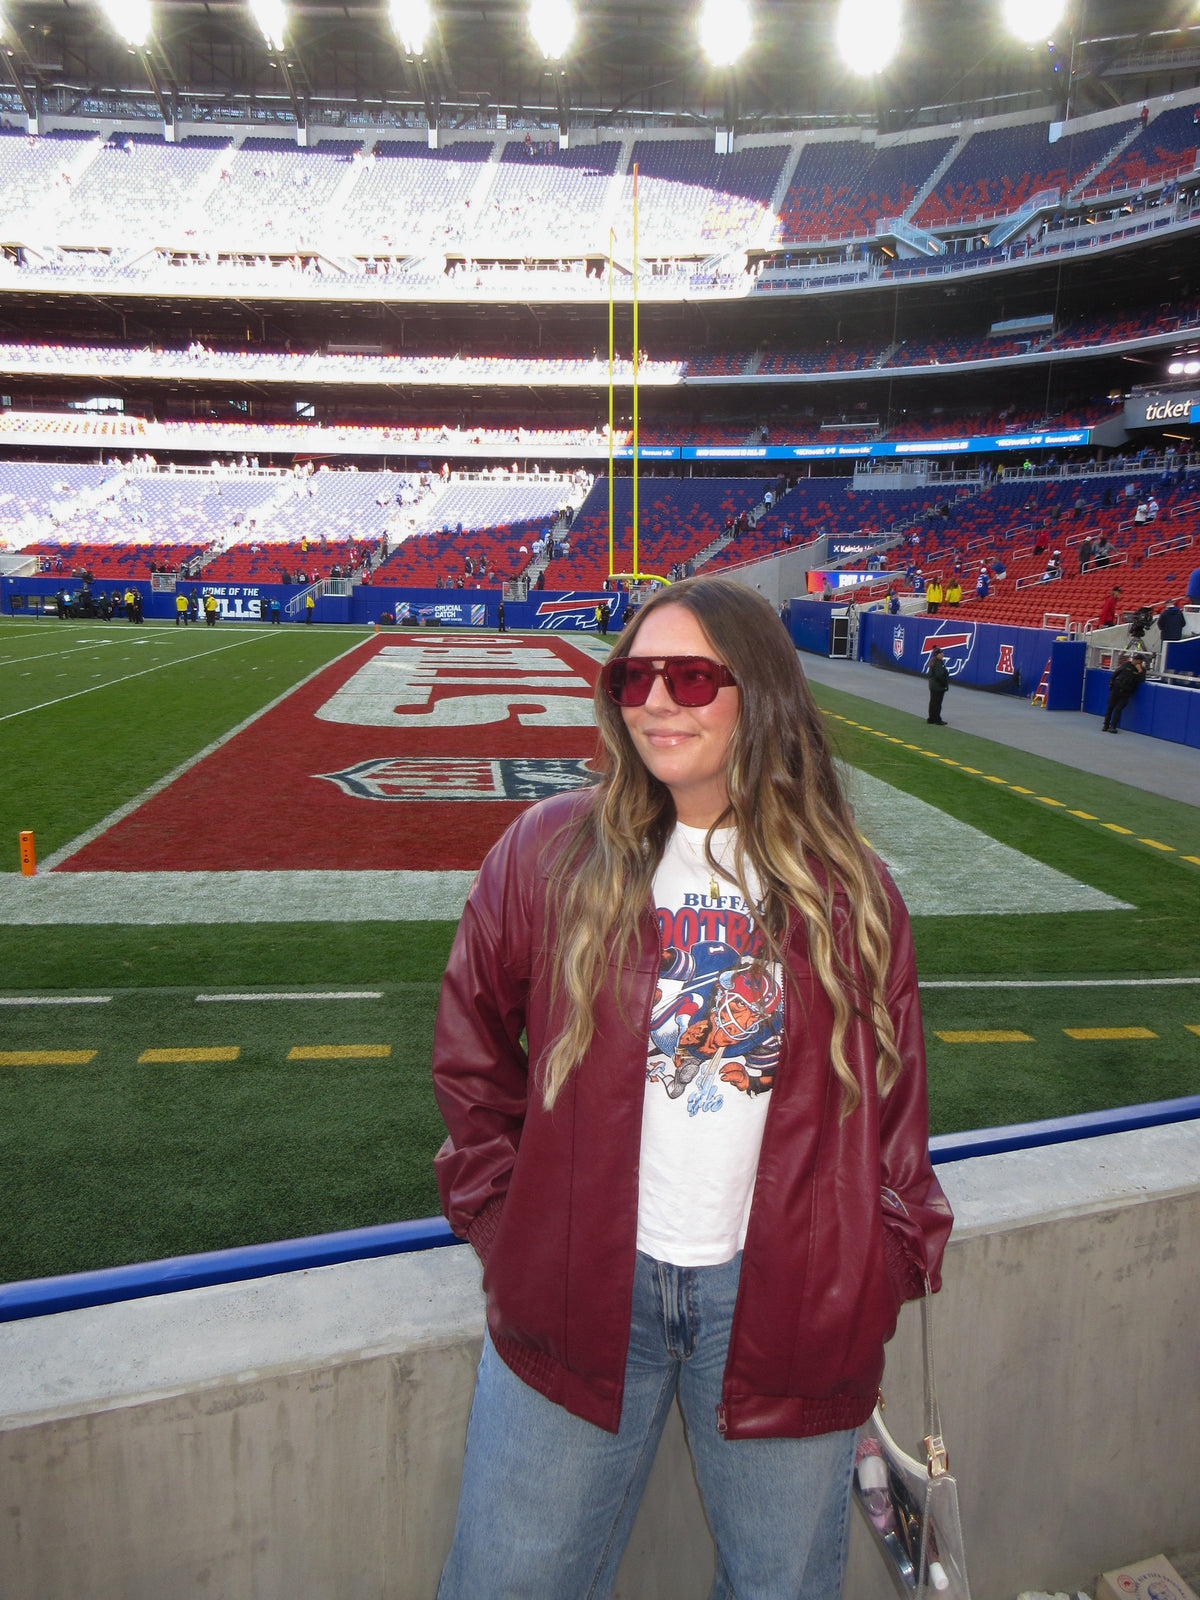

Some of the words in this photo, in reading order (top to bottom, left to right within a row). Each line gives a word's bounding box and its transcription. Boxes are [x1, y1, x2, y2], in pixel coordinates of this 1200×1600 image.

[1145, 400, 1191, 420] ticket
[202, 586, 226, 596] HOME
[228, 587, 240, 596] OF
[243, 588, 259, 596] THE
[434, 604, 462, 612] CRUCIAL
